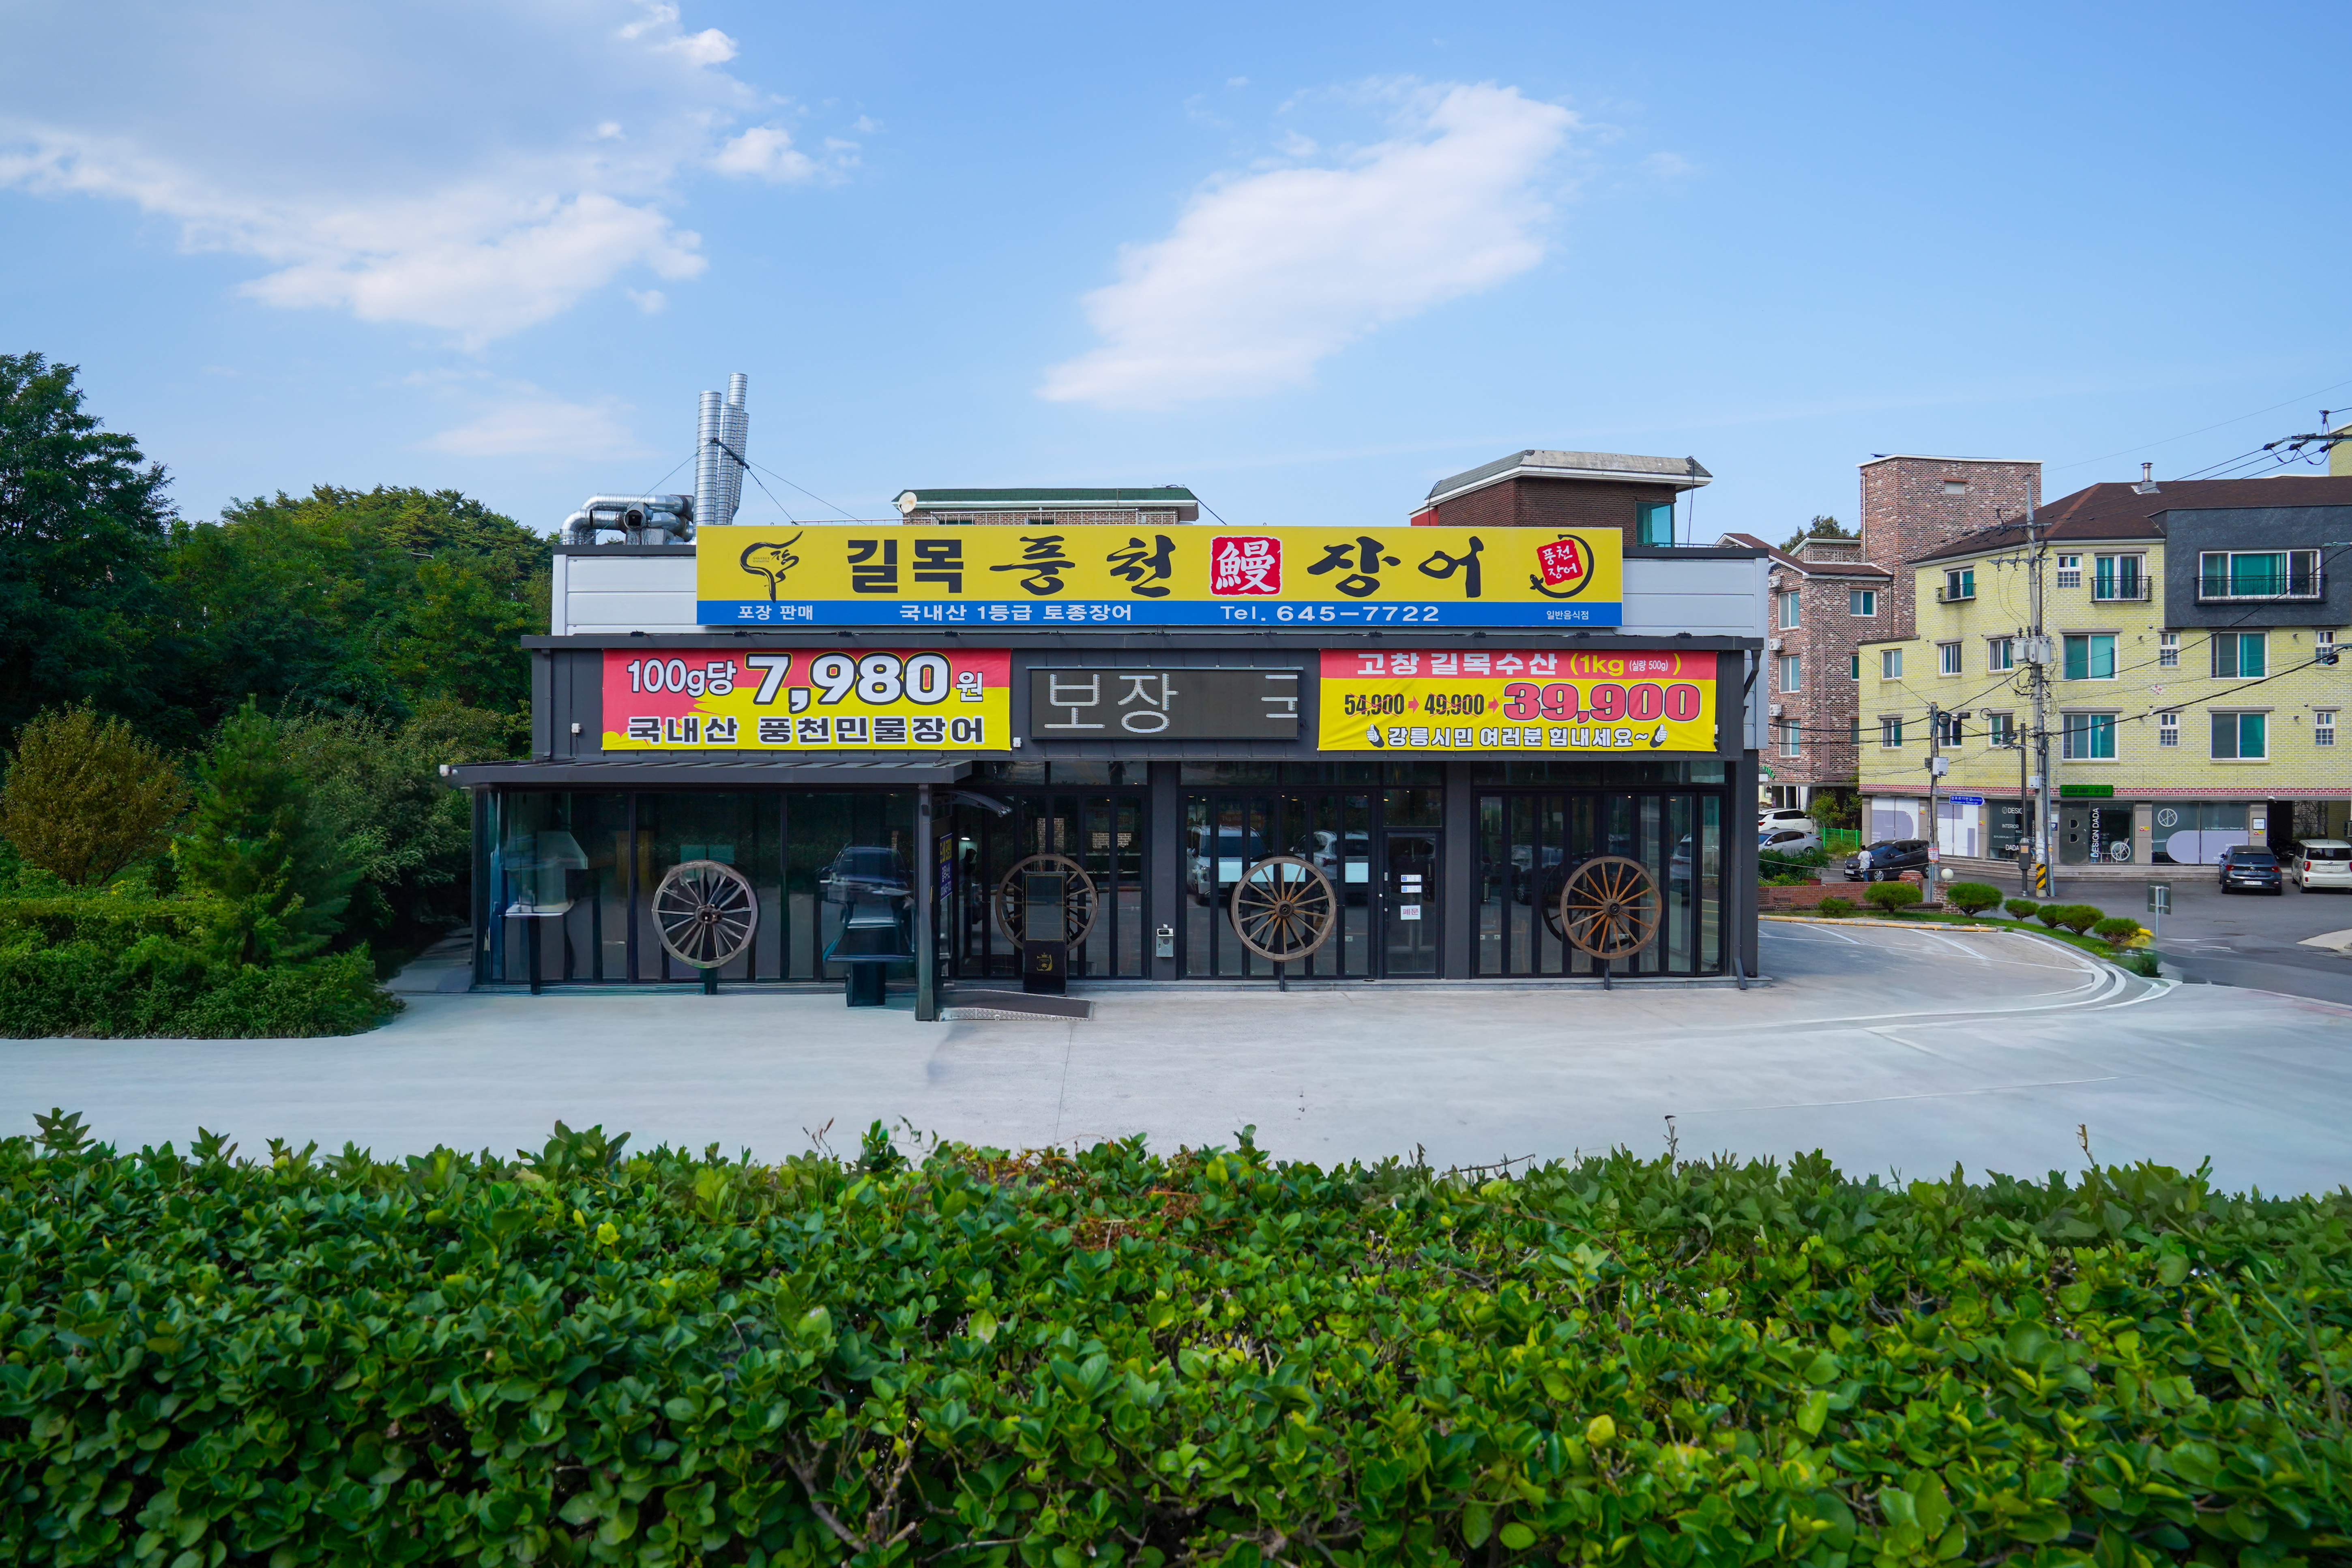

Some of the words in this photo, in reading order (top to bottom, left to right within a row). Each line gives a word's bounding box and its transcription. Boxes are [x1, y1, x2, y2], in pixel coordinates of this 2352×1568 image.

[848, 539, 964, 593] 길목
[1542, 545, 1573, 565] 풍천
[1216, 541, 1277, 593] 鰻
[1307, 536, 1484, 598] 장어
[1547, 563, 1577, 579] 장어
[738, 605, 772, 620] 포장
[780, 605, 813, 620] 판매
[900, 605, 967, 621] 국내산
[977, 605, 1032, 621] 1등급
[1043, 605, 1131, 621] 토종장어
[1220, 606, 1266, 621] Tel.
[1277, 606, 1439, 621] 645-7722
[1547, 610, 1589, 620] 일반음식점
[1357, 653, 1420, 675] 고창
[1431, 653, 1558, 675] 길목수산
[1629, 660, 1646, 671] (실량
[1648, 660, 1668, 671] 500g)
[627, 658, 738, 696] 100g당
[1044, 673, 1179, 733] 보장
[1345, 694, 1405, 716] 54,900
[1425, 694, 1484, 716] 49,900
[1503, 682, 1701, 724] 39,900
[629, 717, 738, 743] 국내산
[759, 717, 983, 743] 풍천민물장어
[1387, 726, 1473, 748] 강릉시민
[1479, 727, 1543, 747] 여러분
